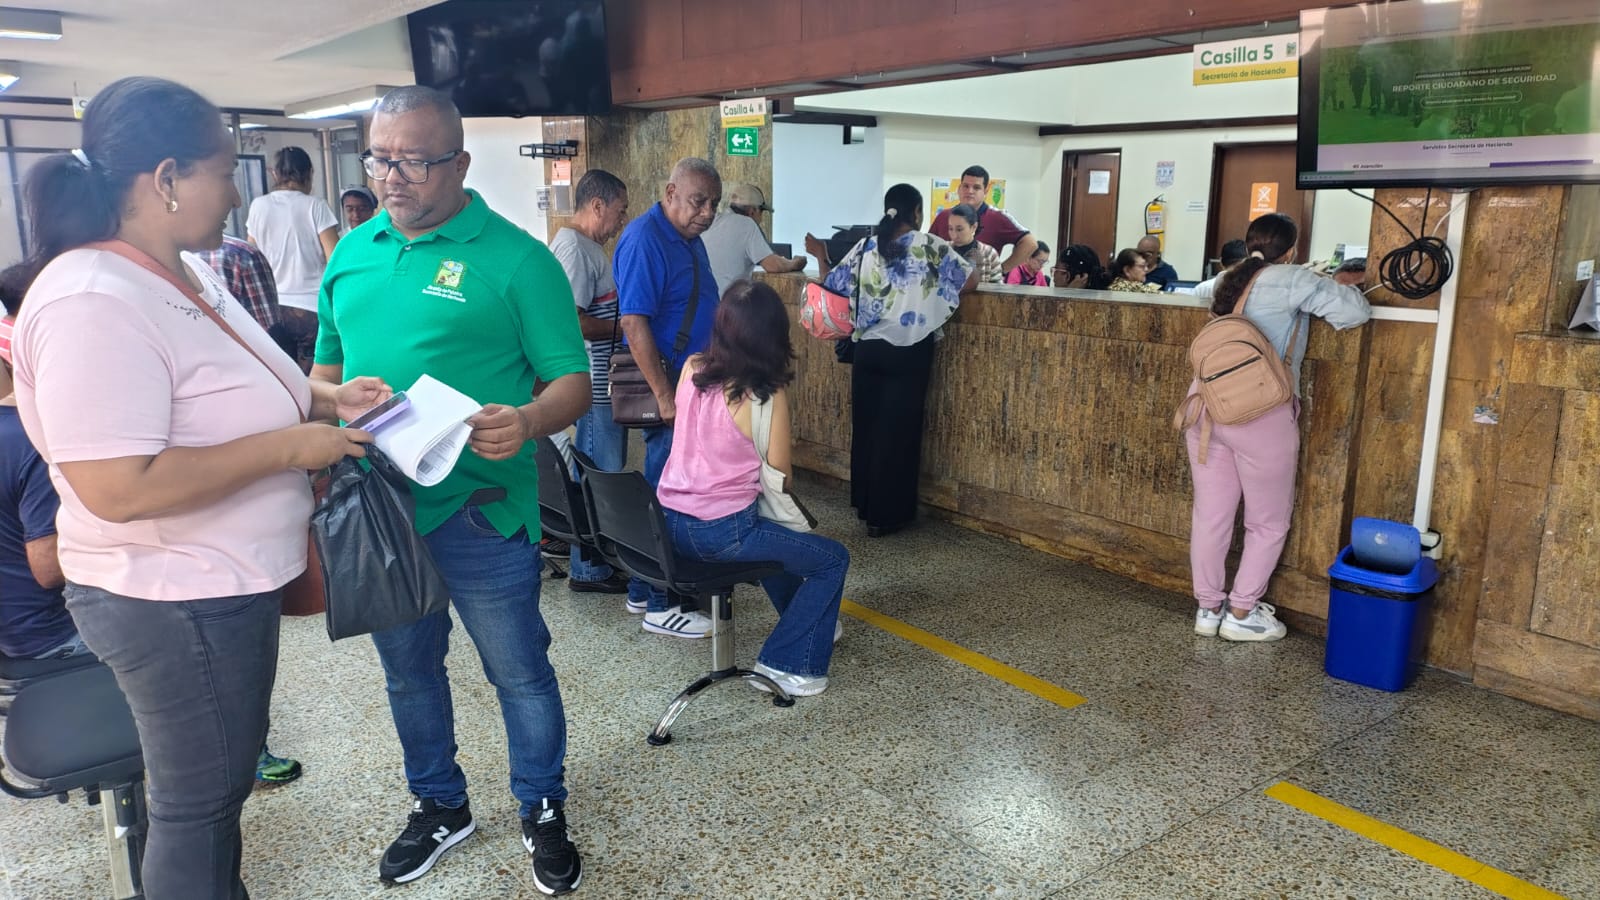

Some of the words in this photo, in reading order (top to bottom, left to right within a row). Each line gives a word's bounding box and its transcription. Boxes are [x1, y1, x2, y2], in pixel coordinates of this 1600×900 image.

[1200, 46, 1258, 66] Casilla
[1263, 44, 1273, 60] 5
[1250, 67, 1286, 76] Hacienda
[1392, 83, 1430, 92] REPORTE
[1432, 79, 1485, 90] CIUDADANO
[1488, 78, 1500, 86] DE
[1502, 73, 1557, 85] SEGURIDAD
[723, 103, 748, 116] Casilla
[749, 104, 754, 113] 4
[431, 825, 450, 843] N
